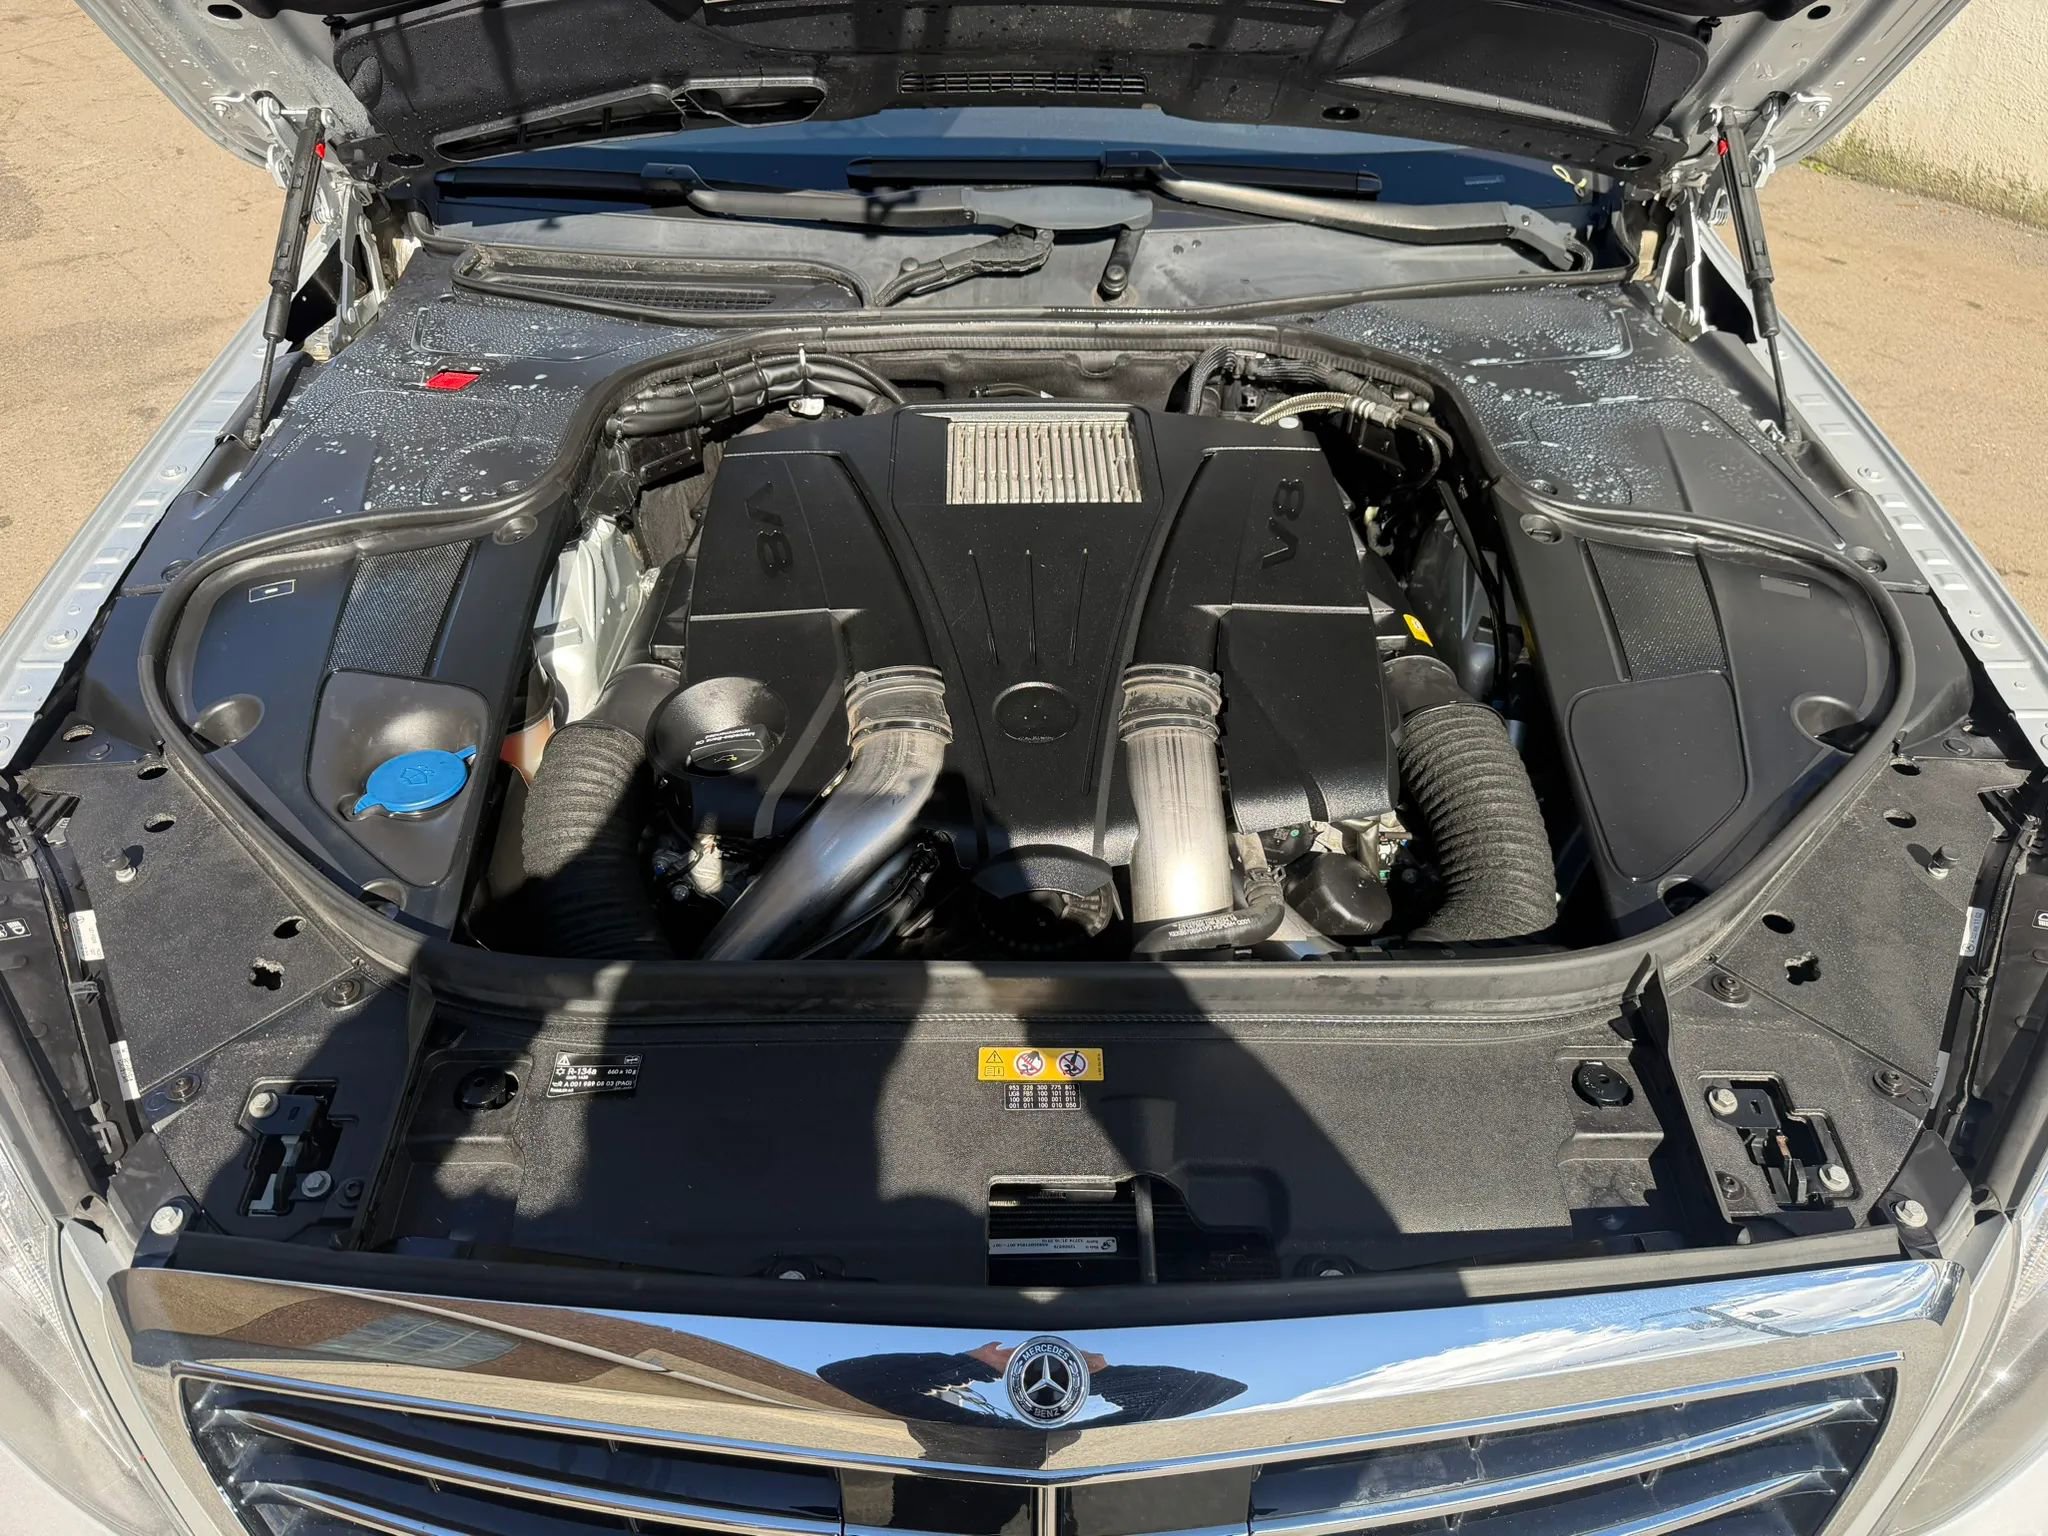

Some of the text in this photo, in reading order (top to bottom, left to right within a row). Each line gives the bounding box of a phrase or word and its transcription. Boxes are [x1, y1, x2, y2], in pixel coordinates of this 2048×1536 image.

[744, 480, 794, 578] V8
[1261, 478, 1305, 569] V8
[567, 1067, 597, 1075] R-134a
[1022, 1344, 1069, 1361] MERCEDES
[1034, 1408, 1061, 1418] BENZ
